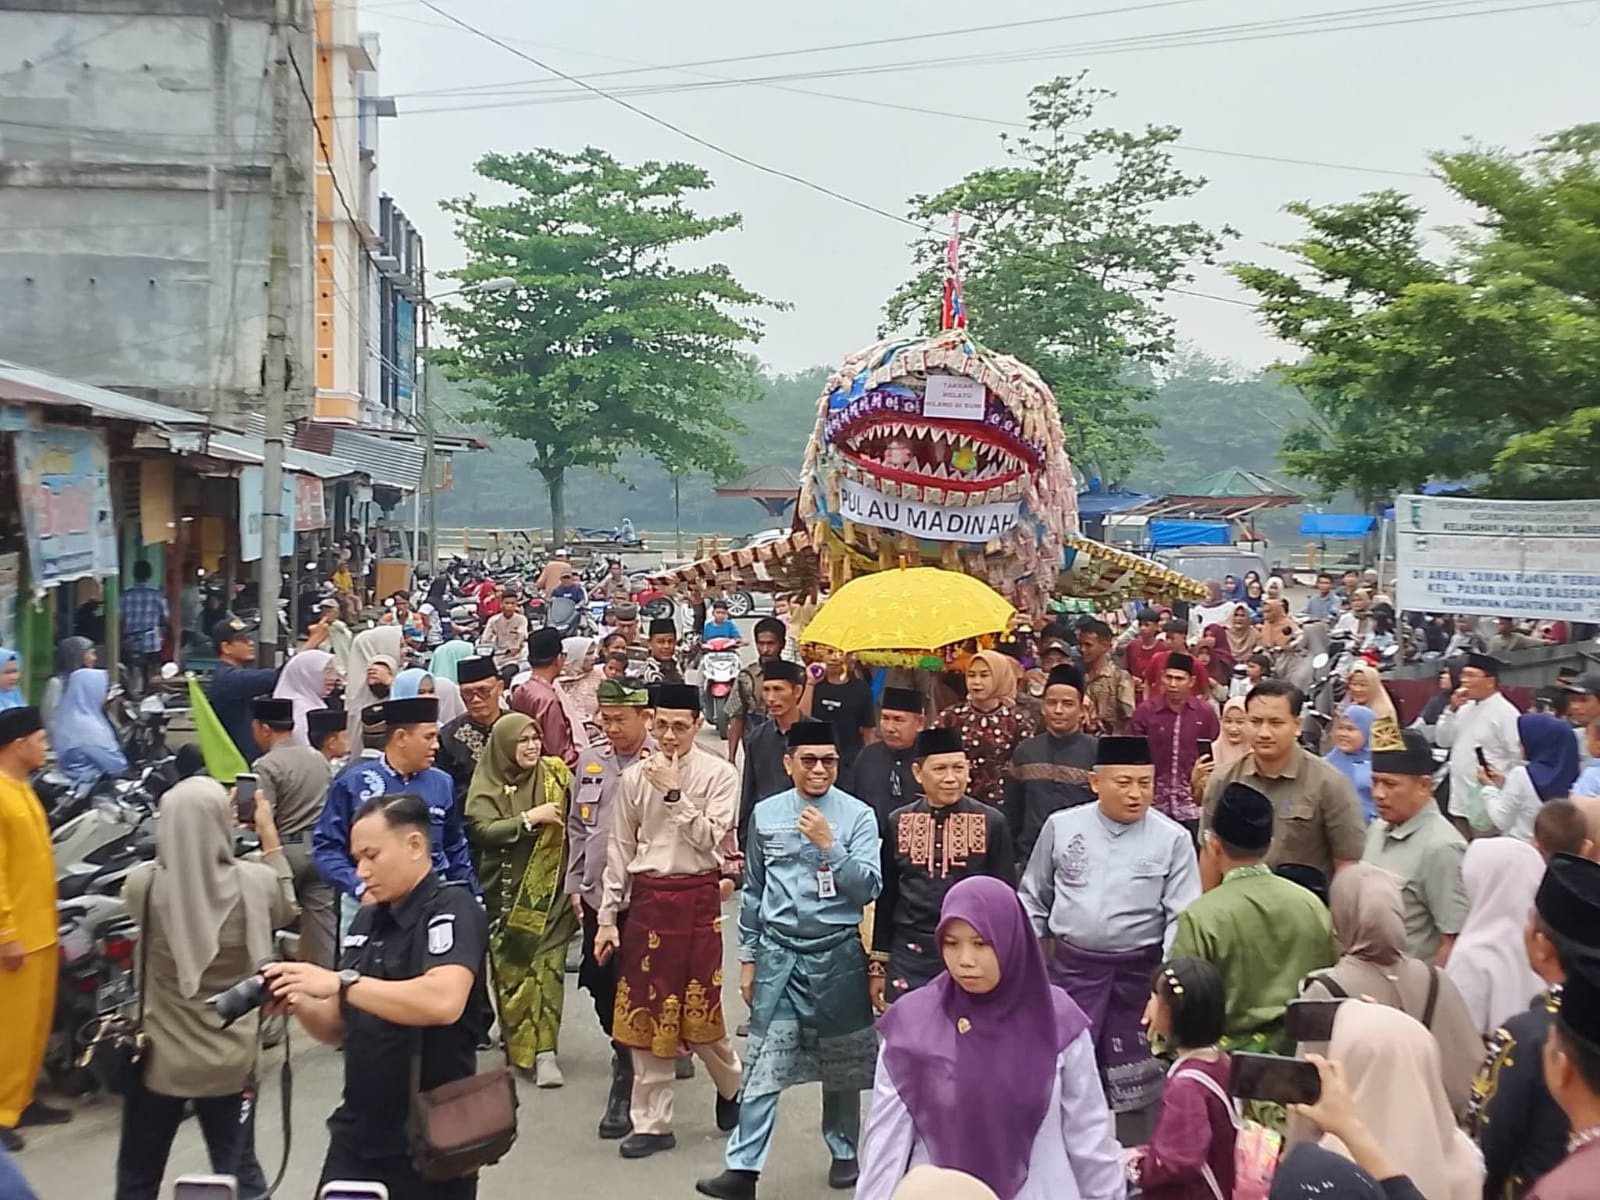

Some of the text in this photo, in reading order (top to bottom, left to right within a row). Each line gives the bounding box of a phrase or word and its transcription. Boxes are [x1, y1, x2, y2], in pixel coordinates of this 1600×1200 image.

[841, 488, 1014, 535] PULAU MADINAH
[1413, 569, 1424, 579] DI
[1428, 570, 1465, 581] AREAL
[1469, 571, 1510, 583] TAMAN
[1458, 584, 1496, 596] PASAR
[1500, 586, 1541, 597] USANG
